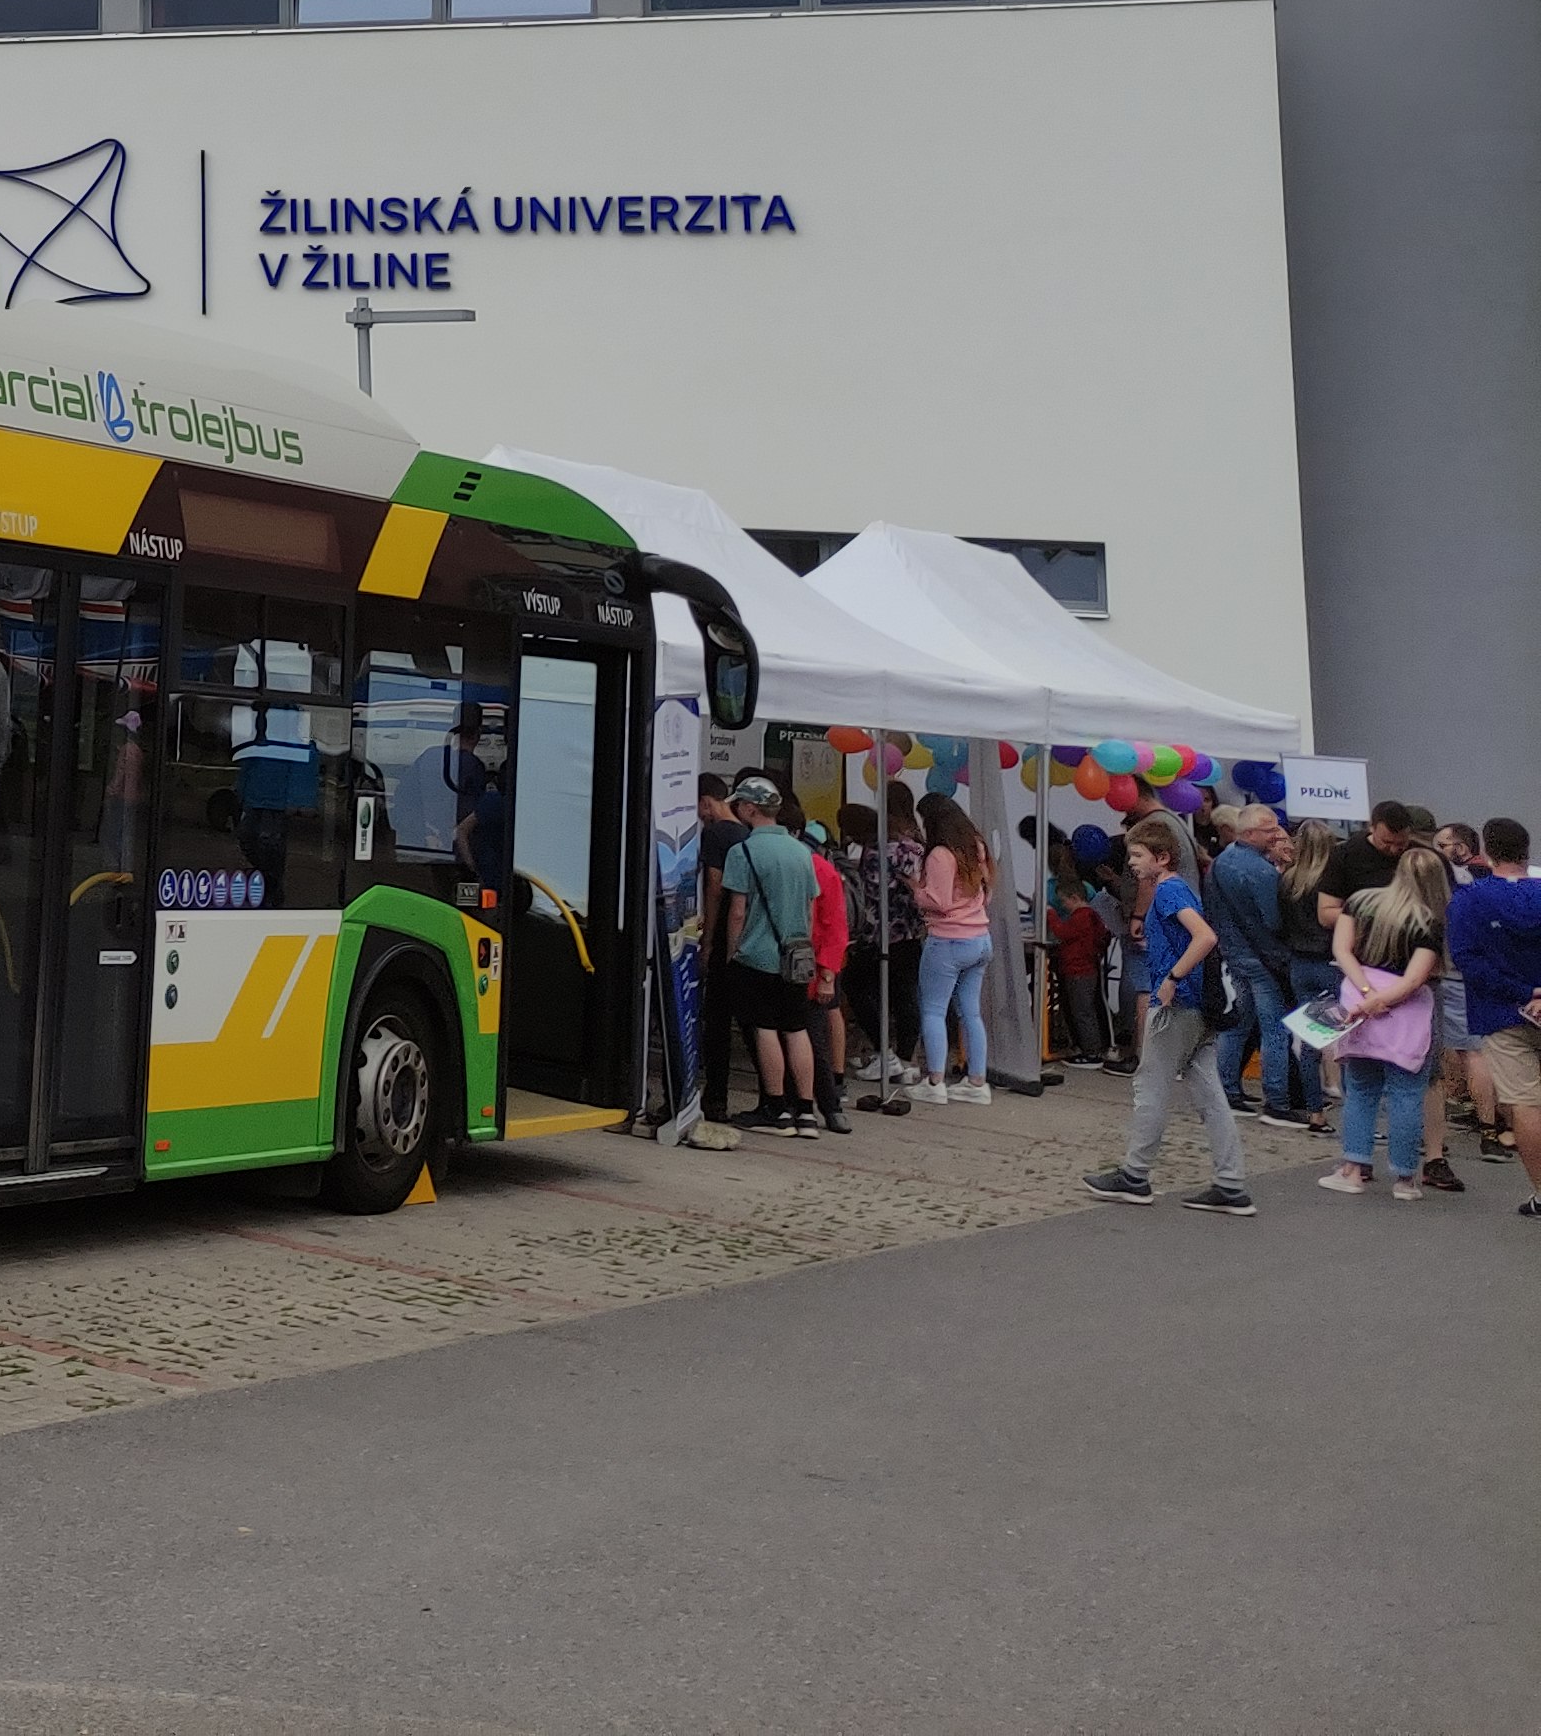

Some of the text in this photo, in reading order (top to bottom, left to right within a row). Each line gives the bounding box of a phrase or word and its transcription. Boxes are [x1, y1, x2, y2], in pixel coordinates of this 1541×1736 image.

[259, 187, 796, 234] ŽILINSKÁ UNIVERZITA
[258, 245, 452, 290] V ŽILINE
[131, 388, 304, 465] trolejbus
[128, 527, 184, 561] NÁSTUP
[522, 586, 561, 616] VÝSTUP
[597, 600, 634, 629] NÁSTUP
